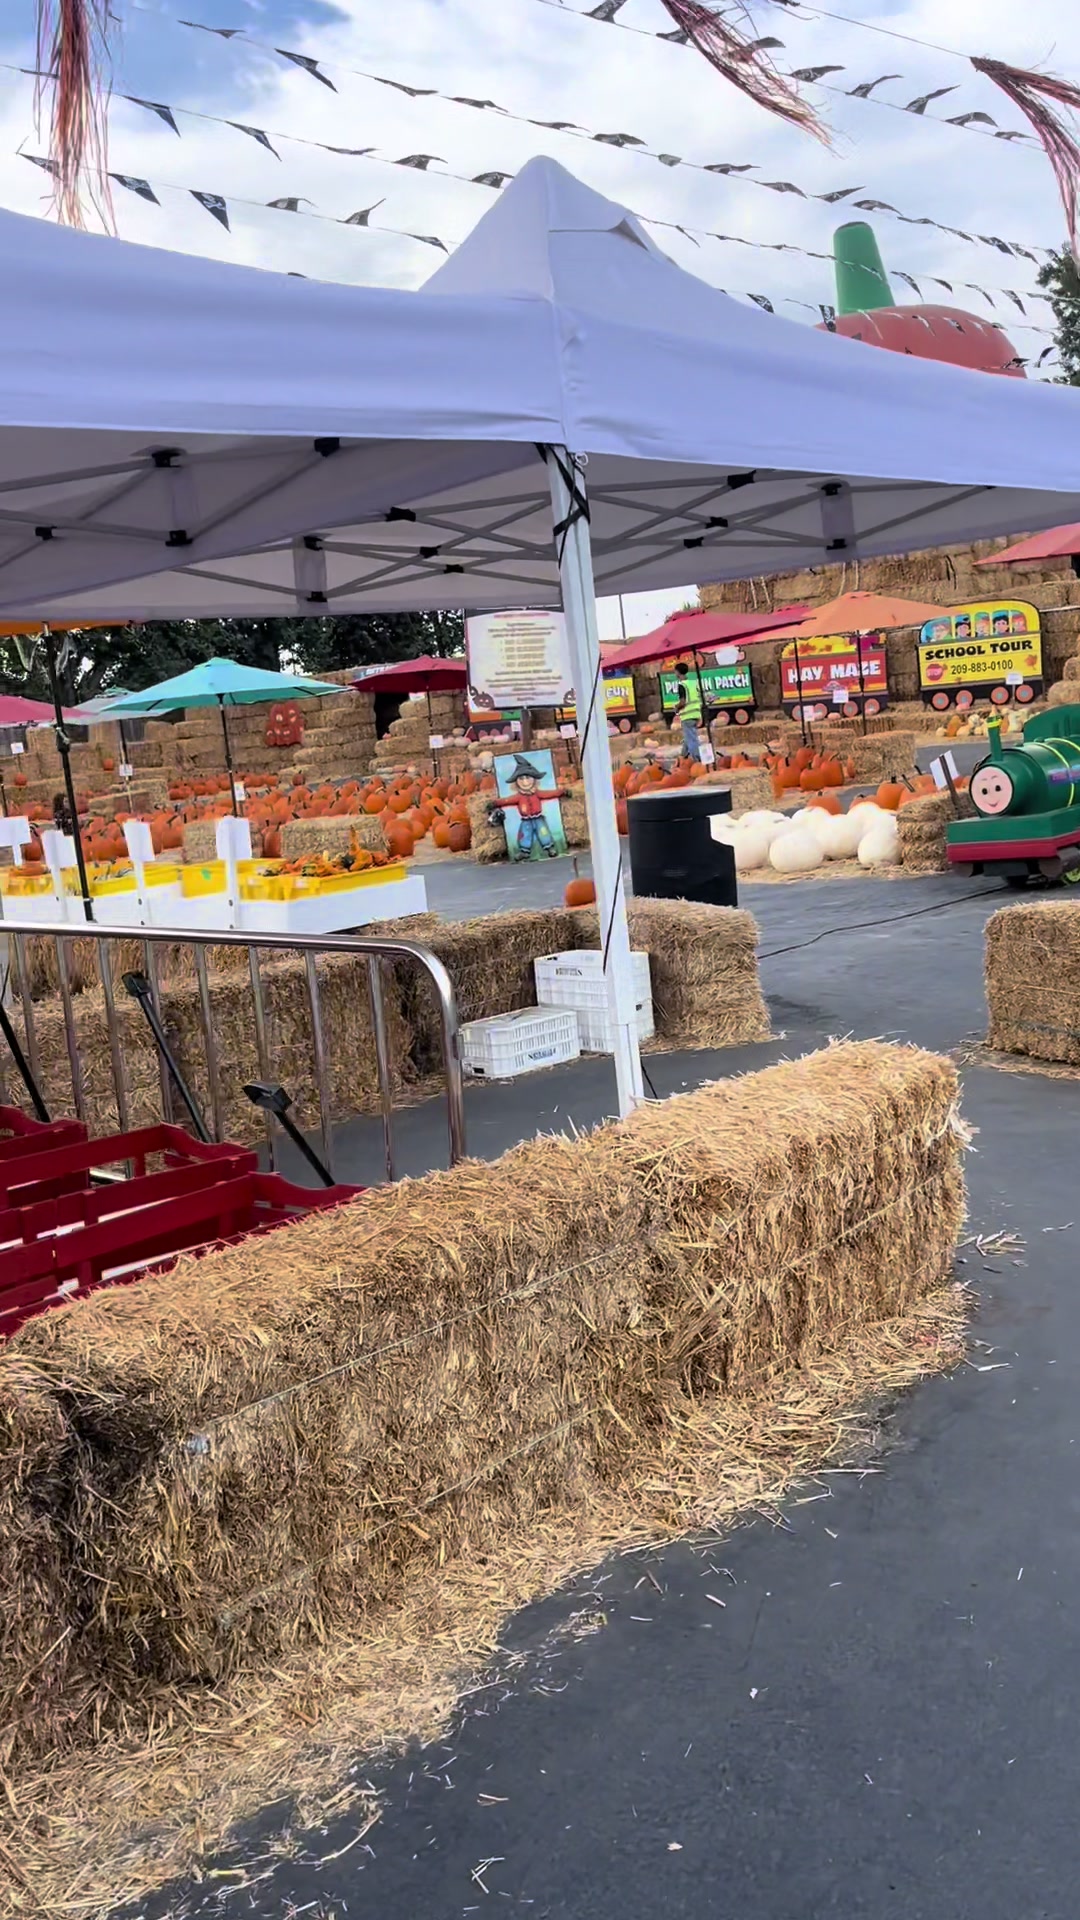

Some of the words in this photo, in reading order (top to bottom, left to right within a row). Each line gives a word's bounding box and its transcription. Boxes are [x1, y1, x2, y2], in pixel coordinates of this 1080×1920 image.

[925, 645, 986, 661] SCHOOL
[990, 640, 1033, 654] TOUR
[787, 665, 824, 684] HAY
[829, 659, 881, 679] MAZE
[950, 659, 1014, 675] 209-883-0100
[714, 673, 750, 691] PATCH
